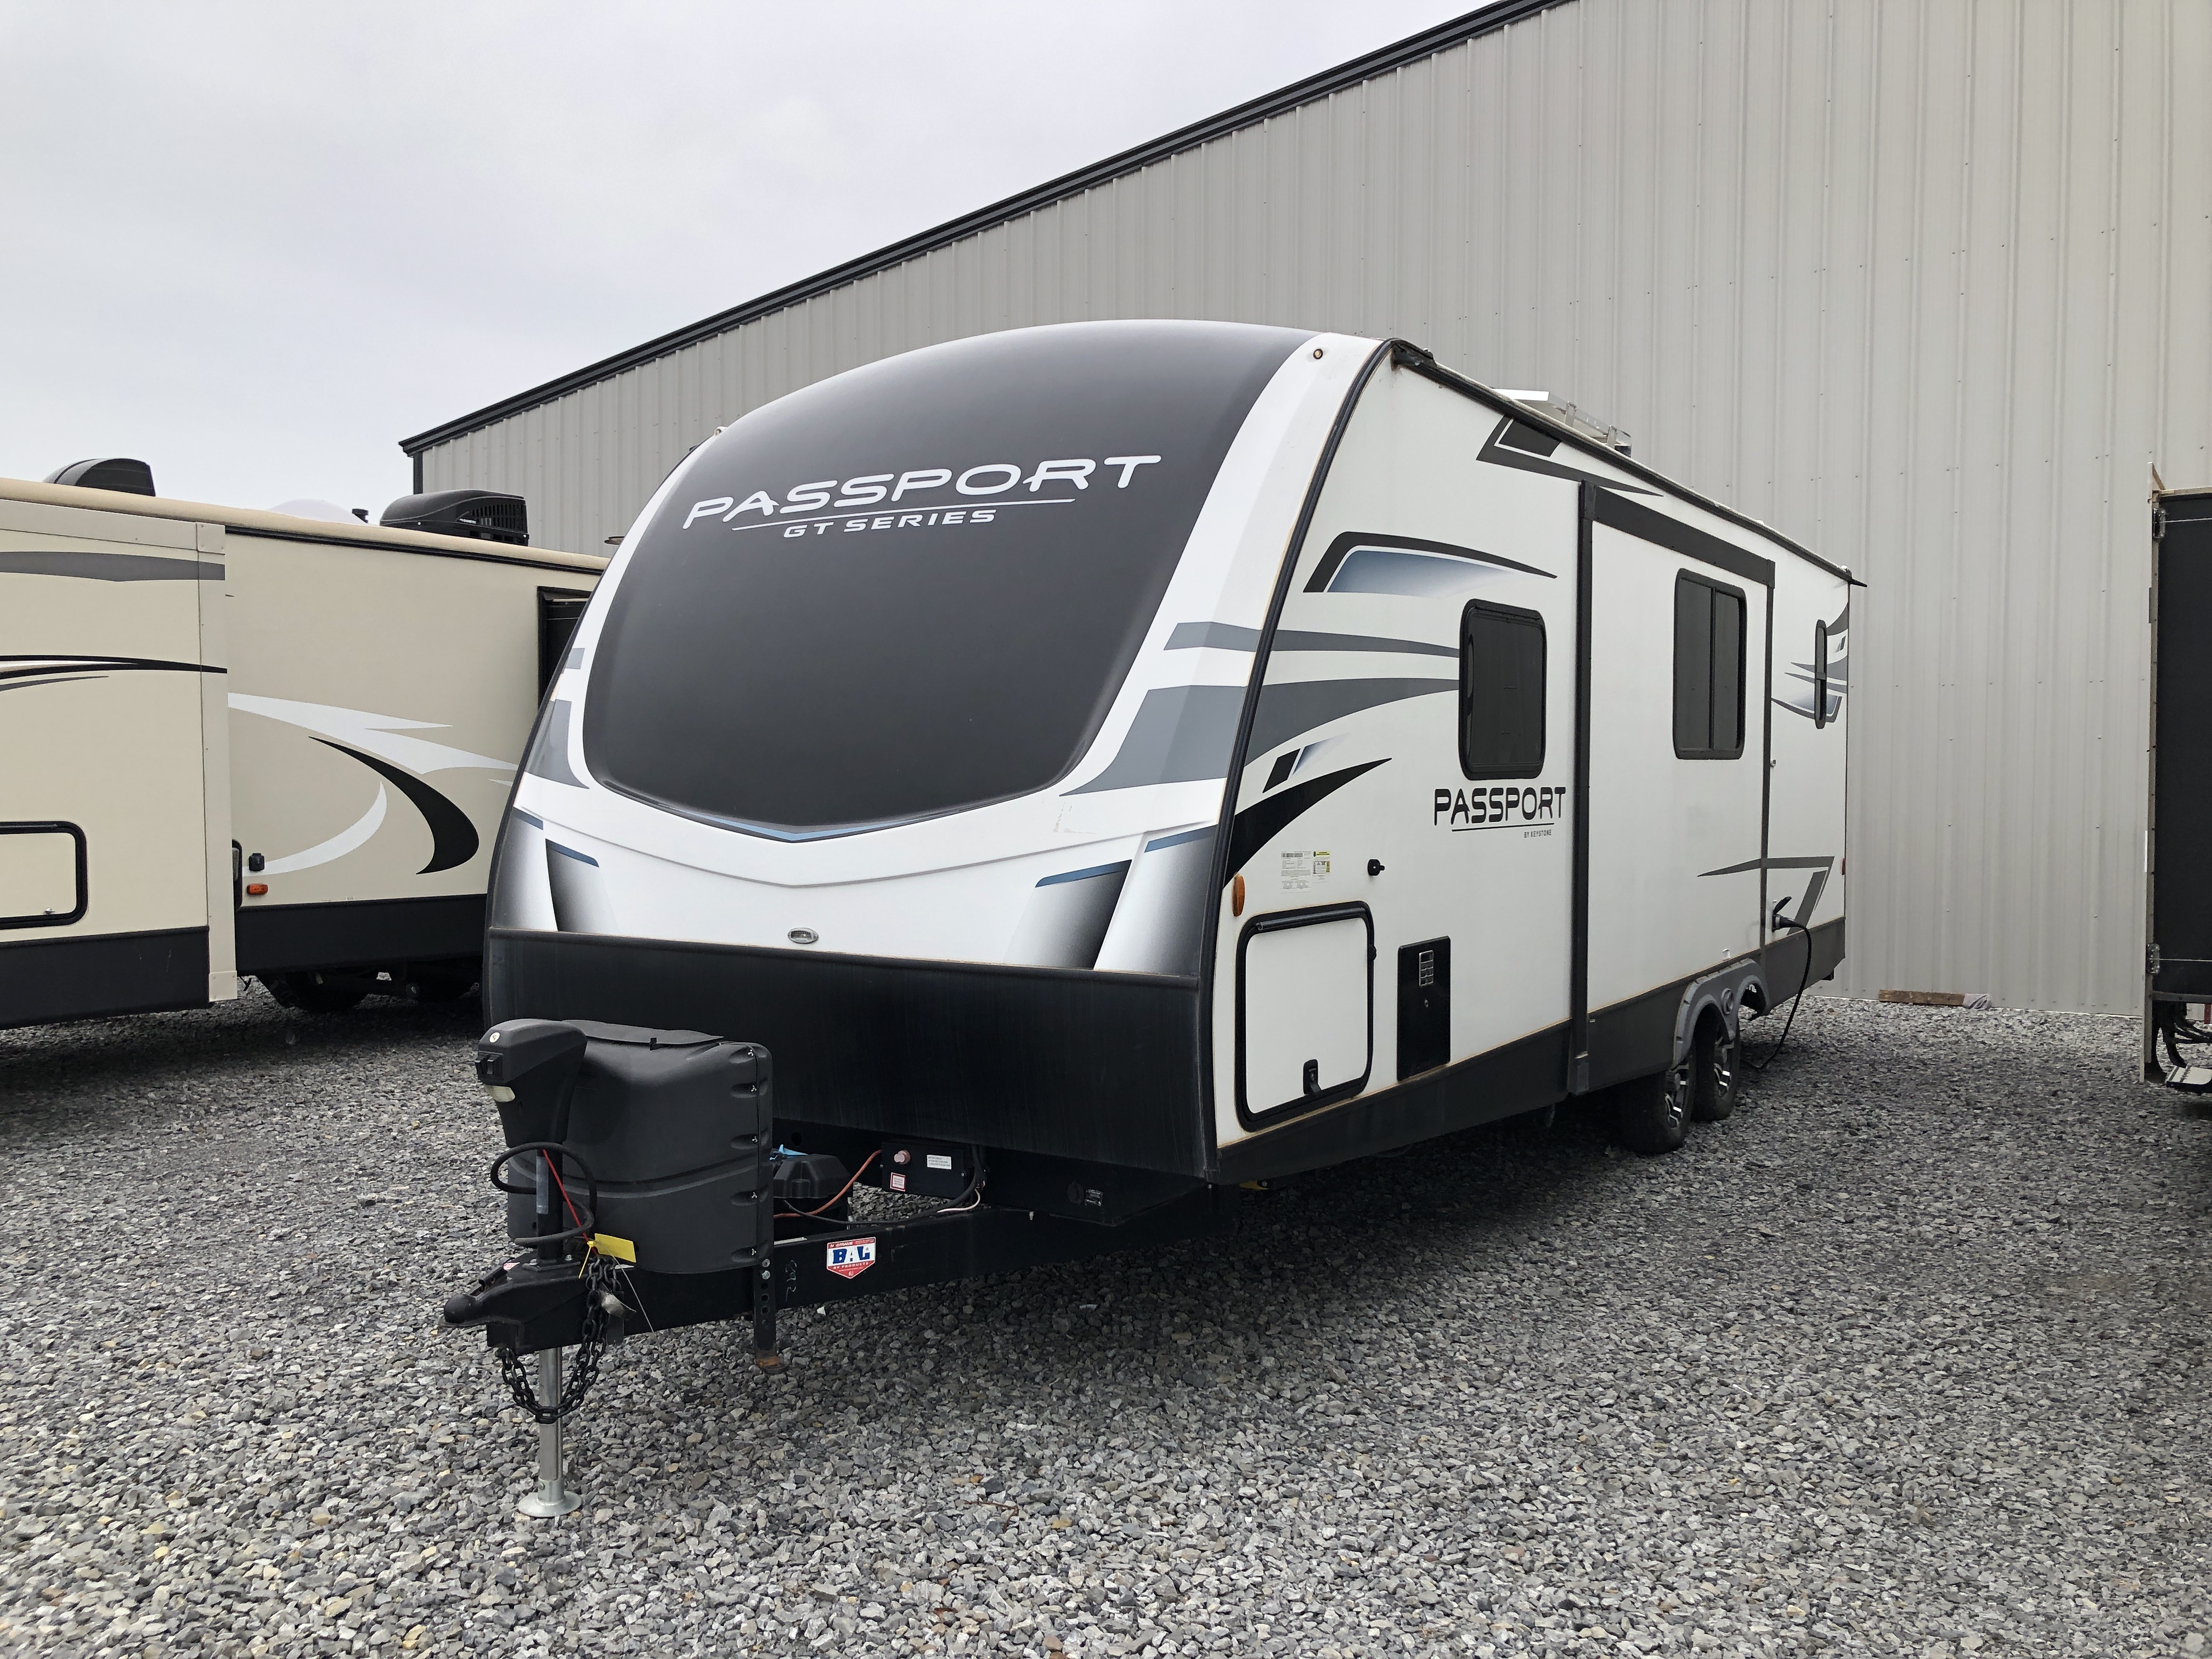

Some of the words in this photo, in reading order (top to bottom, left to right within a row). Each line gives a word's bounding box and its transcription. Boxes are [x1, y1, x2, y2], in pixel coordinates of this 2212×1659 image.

[682, 455, 1161, 529] PASSPORT
[783, 521, 834, 538] GT
[843, 509, 997, 532] SERIES
[1434, 787, 1566, 826] PASSPORT
[1531, 829, 1552, 838] KEYSTONE
[833, 1246, 870, 1264] BAL
